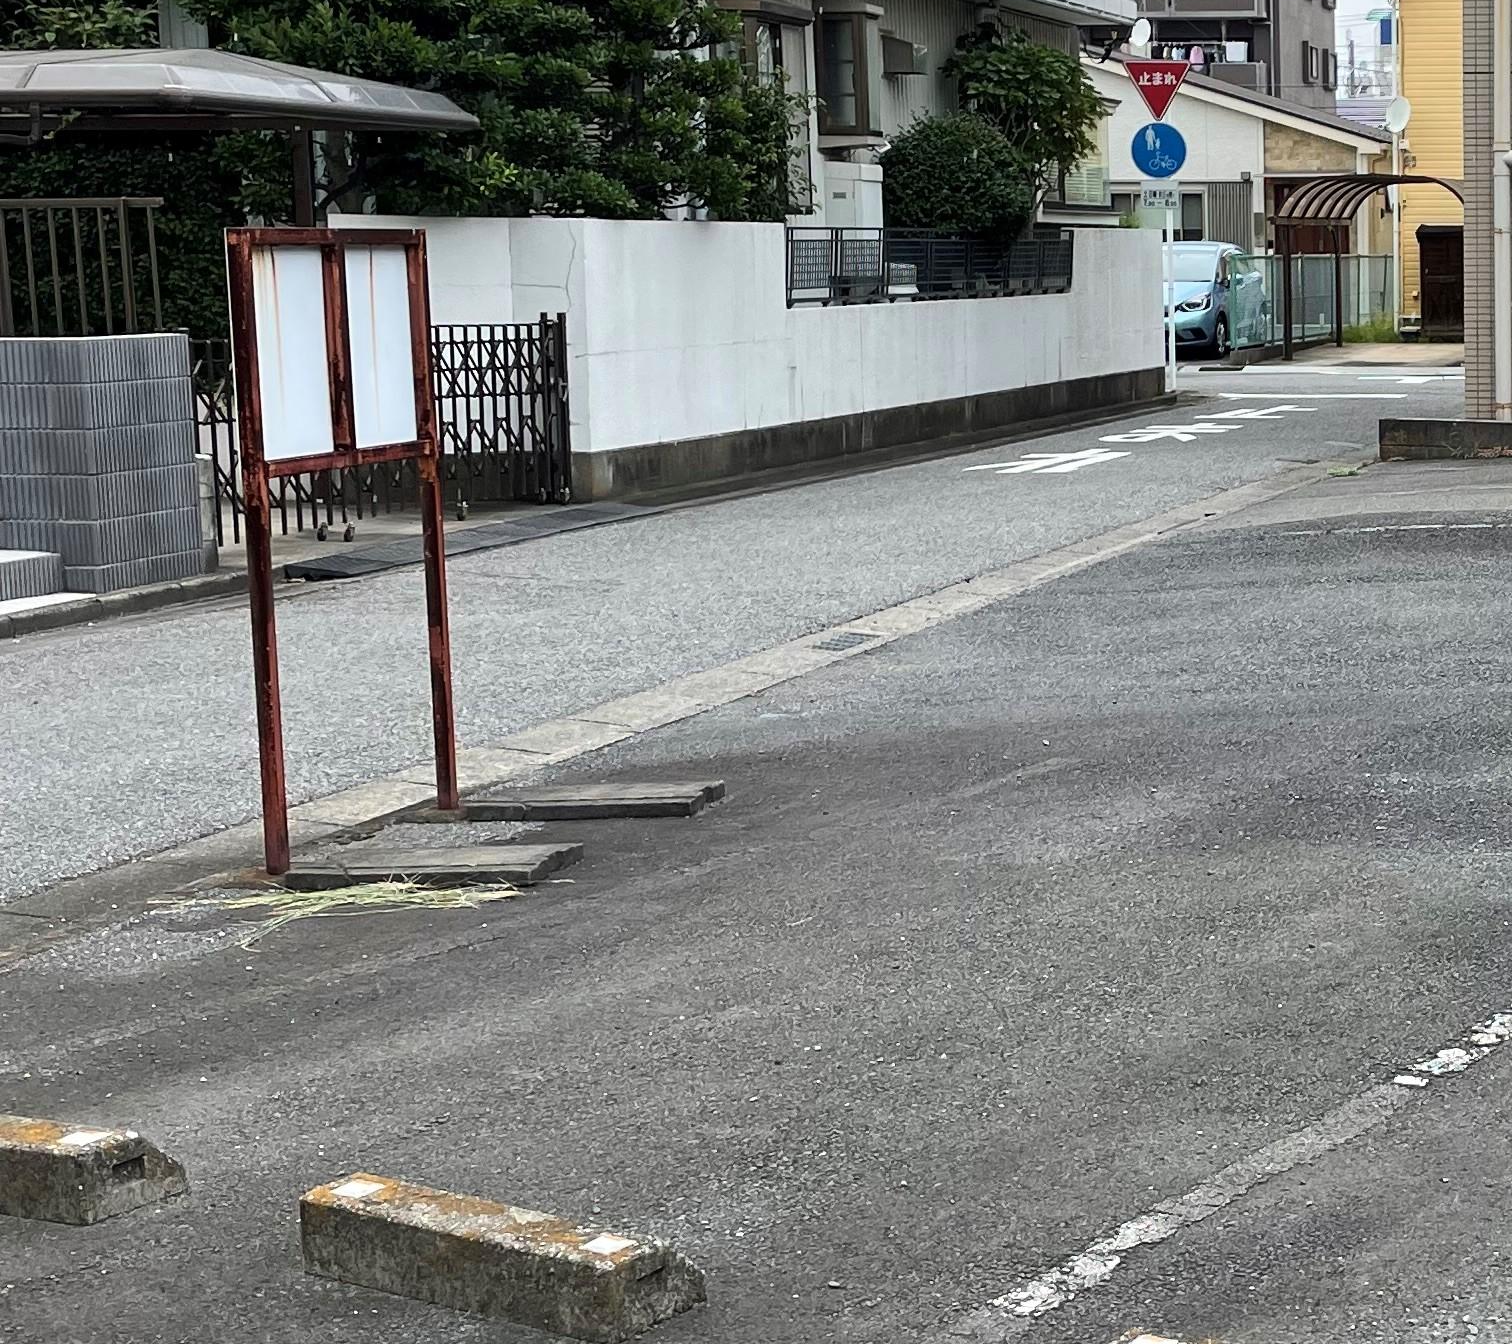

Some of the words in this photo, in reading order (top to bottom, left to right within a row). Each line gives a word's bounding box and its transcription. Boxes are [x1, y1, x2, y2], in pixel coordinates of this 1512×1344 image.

[1138, 71, 1178, 86] 止まれ
[962, 404, 1319, 474] 止まれ
